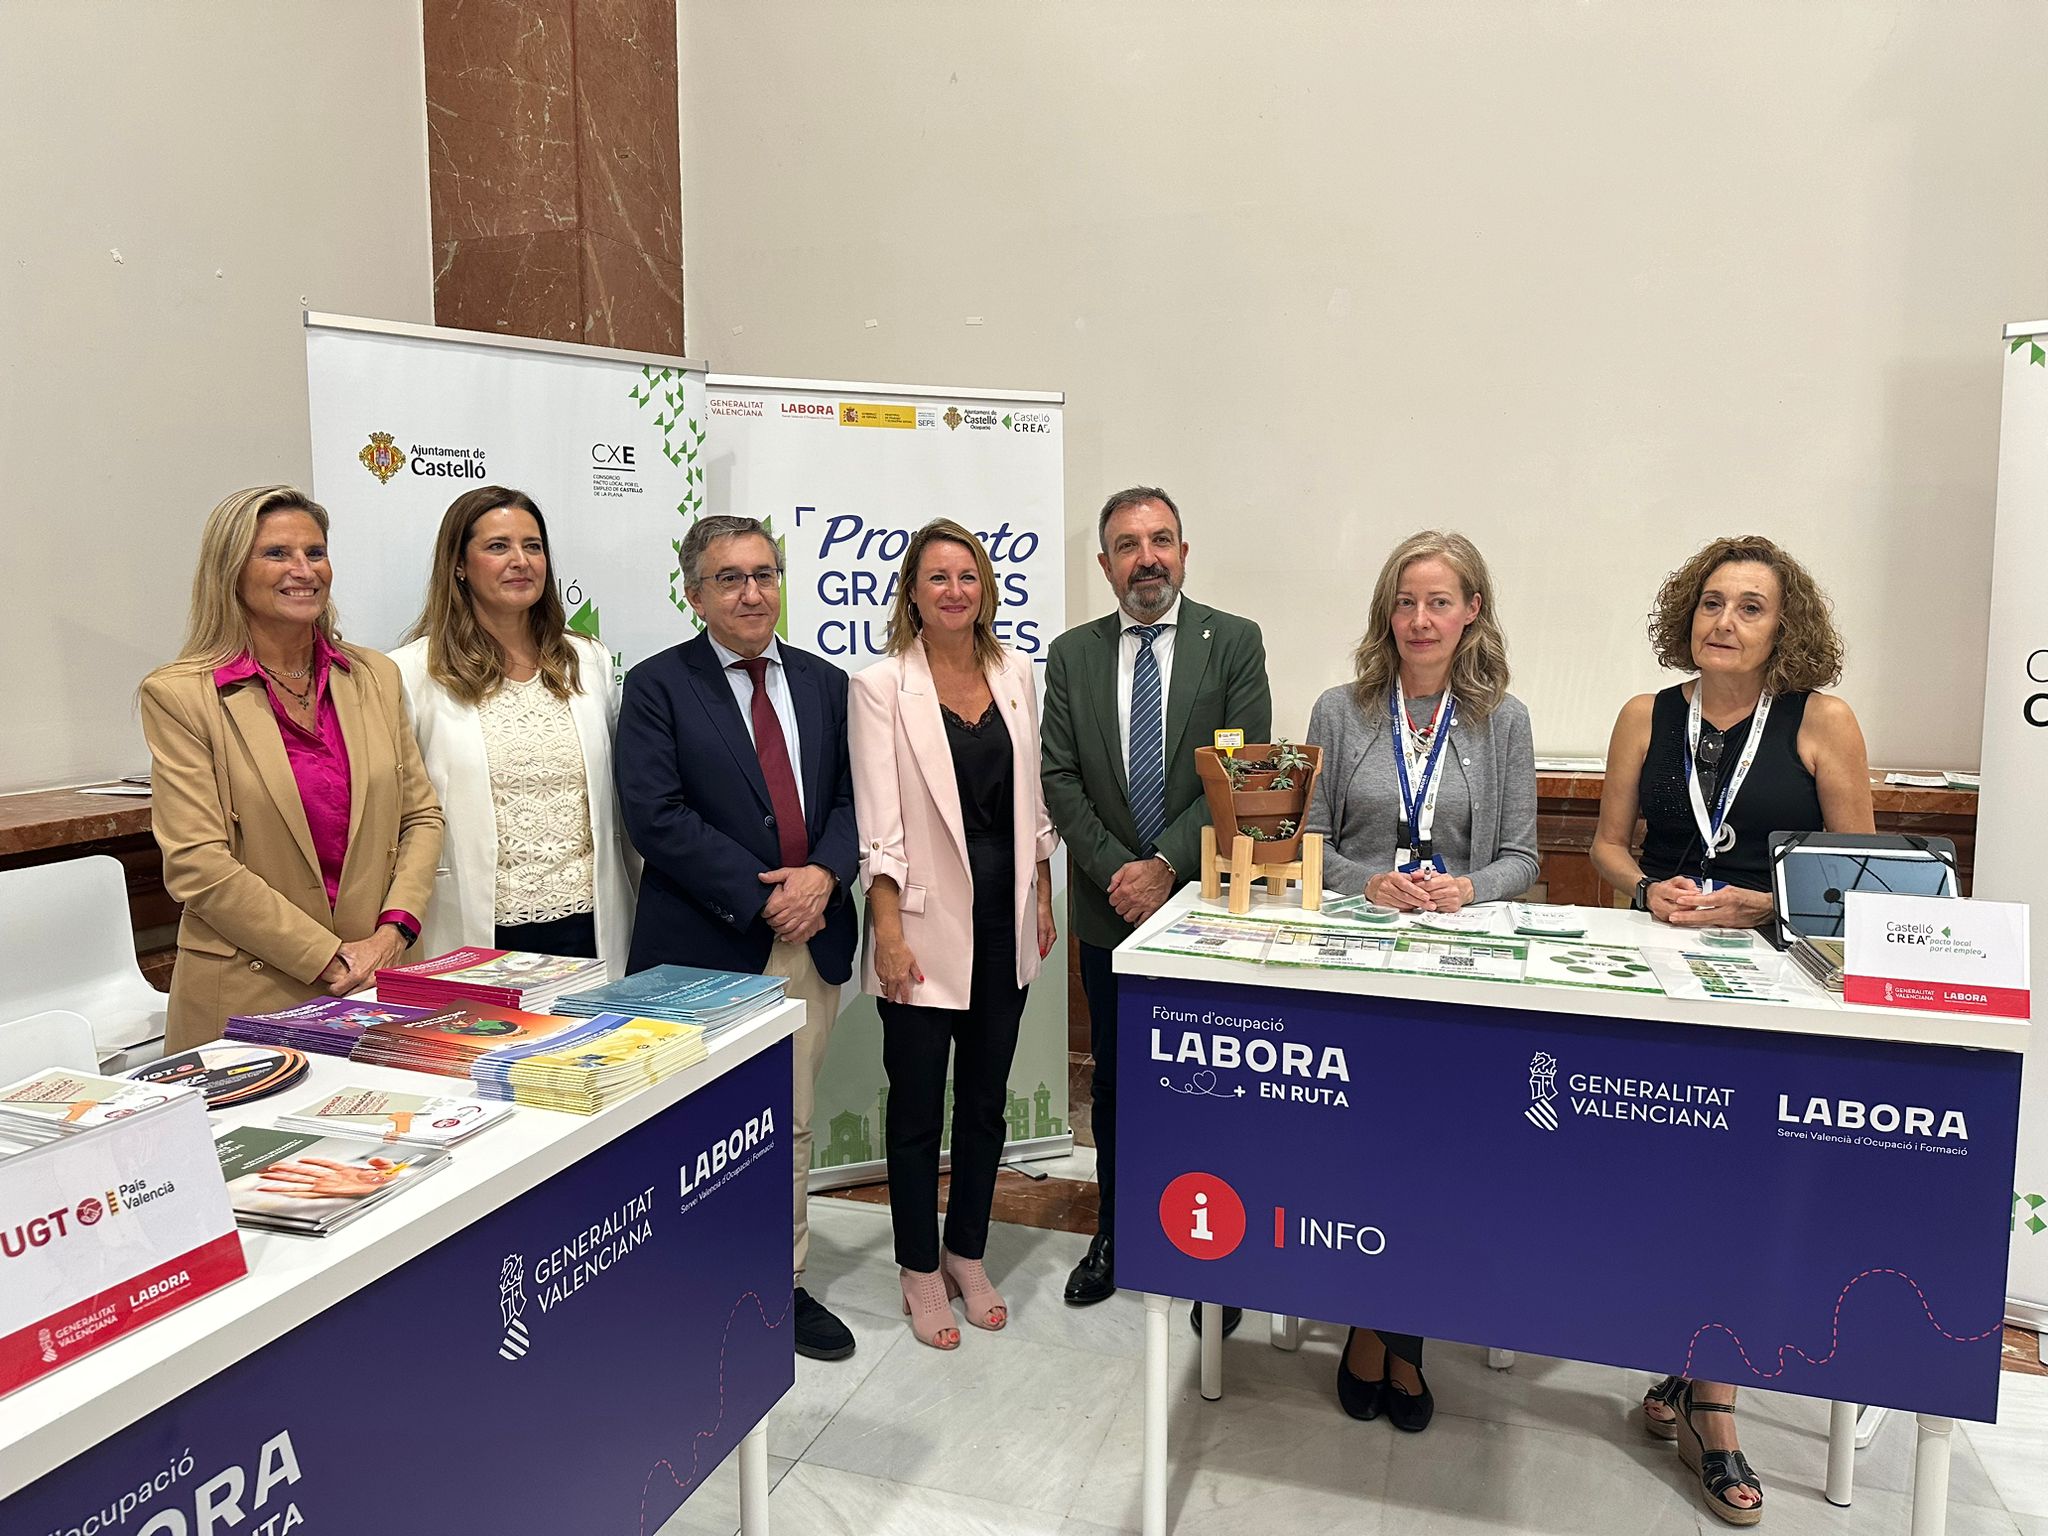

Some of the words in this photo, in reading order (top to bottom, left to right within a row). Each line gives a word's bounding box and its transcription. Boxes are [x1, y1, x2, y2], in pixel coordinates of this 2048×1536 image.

[710, 400, 764, 409] GENERALITAT
[711, 408, 763, 417] VALENCIANA
[781, 403, 834, 415] LABORA
[1013, 412, 1050, 423] Castelló
[964, 415, 998, 425] Castelló
[1014, 423, 1045, 433] CREA
[410, 444, 471, 459] Ajuntament
[473, 447, 486, 459] de
[591, 443, 635, 465] CXE
[411, 457, 486, 479] Castelló
[1886, 921, 1934, 935] Castelló
[1886, 933, 1926, 945] CREA
[1929, 938, 1952, 946] pacto
[1953, 939, 1972, 947] local
[1929, 945, 1943, 953] por
[1953, 946, 1982, 956] empleo
[1894, 987, 1935, 996] GENERALITAT
[1895, 993, 1934, 1001] VALENCIANA
[1943, 991, 1988, 1003] LABORA
[1152, 1005, 1198, 1023] Fòrum
[1202, 1010, 1285, 1032] d'ocupació
[1151, 1028, 1350, 1082] LABORA
[1259, 1081, 1286, 1100] EN
[1290, 1084, 1350, 1108] RUTA
[1569, 1074, 1735, 1108] GENERALITAT
[1570, 1097, 1729, 1131] VALENCIANA
[1778, 1094, 1969, 1140] LABORA
[680, 1107, 774, 1197] LABORA
[1777, 1128, 1808, 1140] Servei
[1810, 1131, 1852, 1144] Valencià
[1920, 1143, 1968, 1156] Formació
[680, 1195, 699, 1214] Servei
[698, 1179, 721, 1201] Valencià
[752, 1139, 775, 1162] Formació
[123, 1180, 175, 1211] Valencià
[0, 1207, 69, 1258] UGT
[119, 1178, 147, 1197] País
[534, 1186, 655, 1285] GENERALITAT
[1300, 1216, 1386, 1255] INFO
[537, 1218, 653, 1314] VALENCIANA
[129, 1270, 190, 1307] LABORA
[55, 1303, 117, 1339] GENERALITAT
[57, 1314, 119, 1348] VALENCIANA
